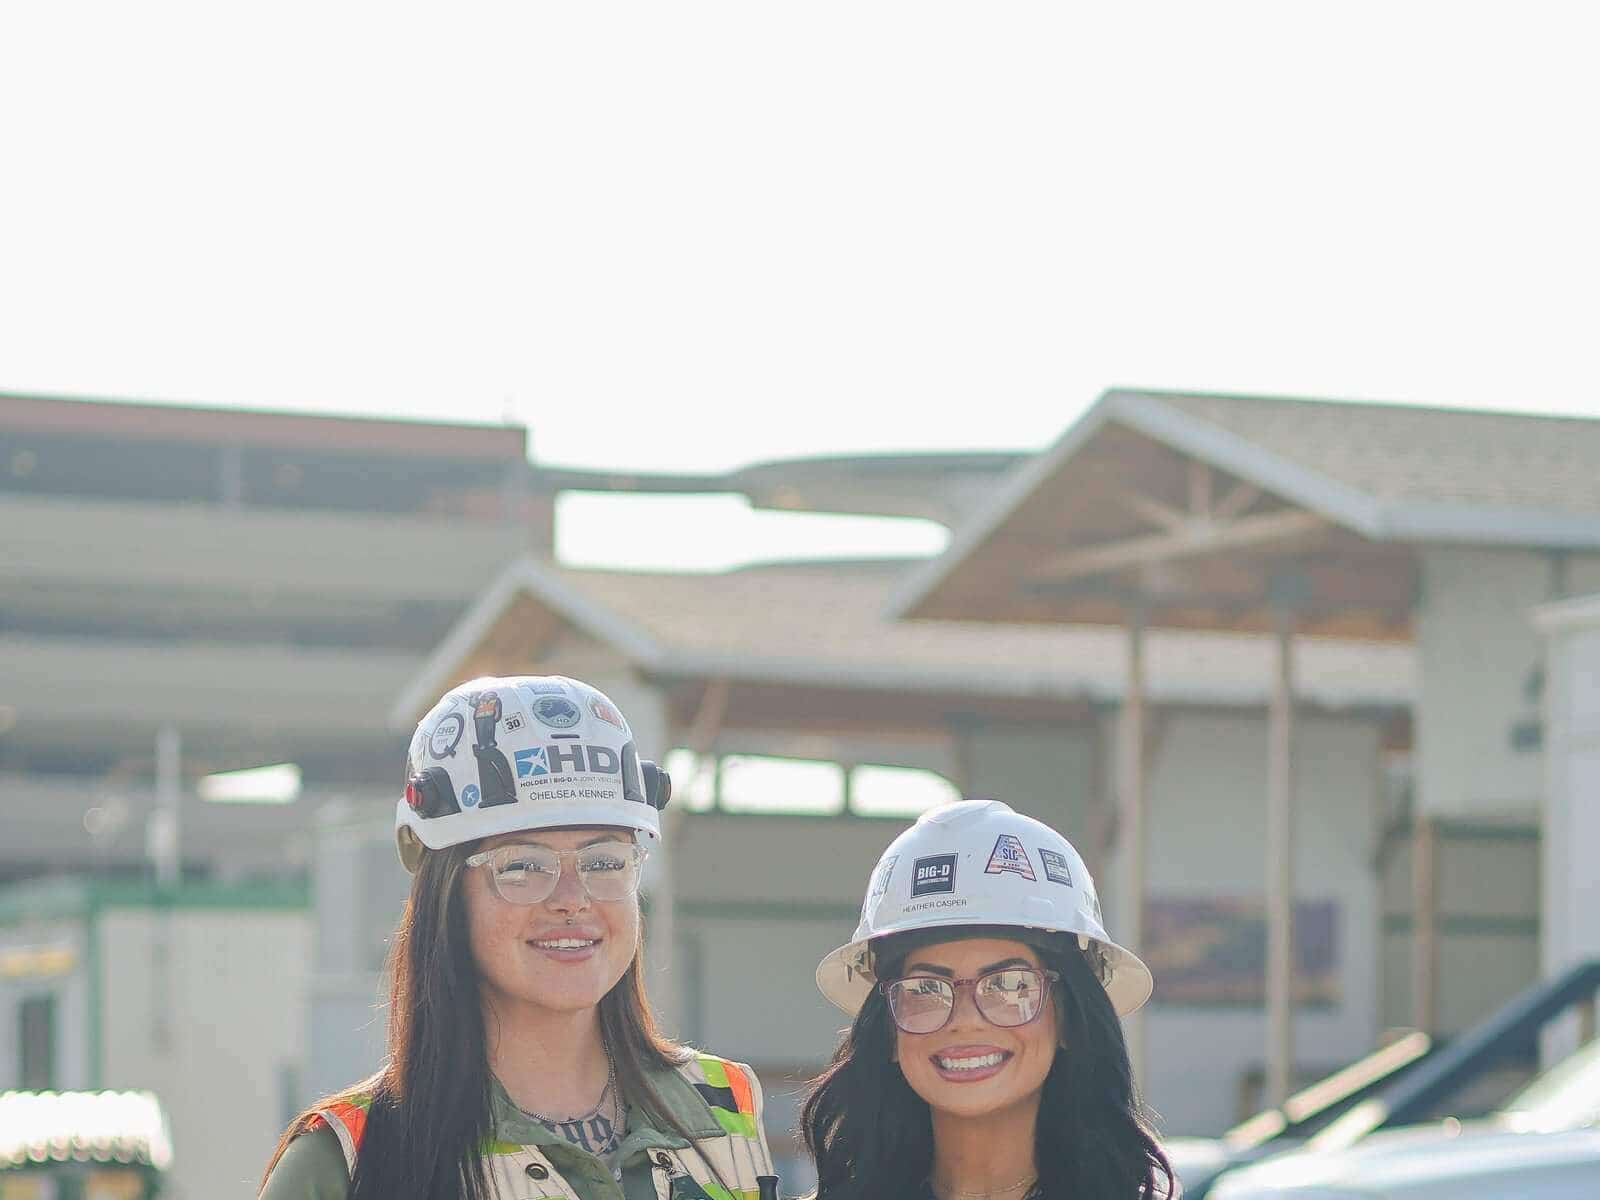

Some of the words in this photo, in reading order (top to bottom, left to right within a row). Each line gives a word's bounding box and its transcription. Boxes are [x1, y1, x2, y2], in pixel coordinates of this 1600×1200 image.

[506, 718, 521, 731] 30
[546, 745, 620, 774] HD
[520, 778, 548, 788] HOLDER
[529, 789, 577, 801] CHELSEA
[579, 789, 616, 800] KENNER
[1002, 848, 1019, 861] SLC
[917, 864, 951, 880] BIG-D
[902, 901, 935, 913] HEATHER
[936, 899, 967, 909] CASPER
